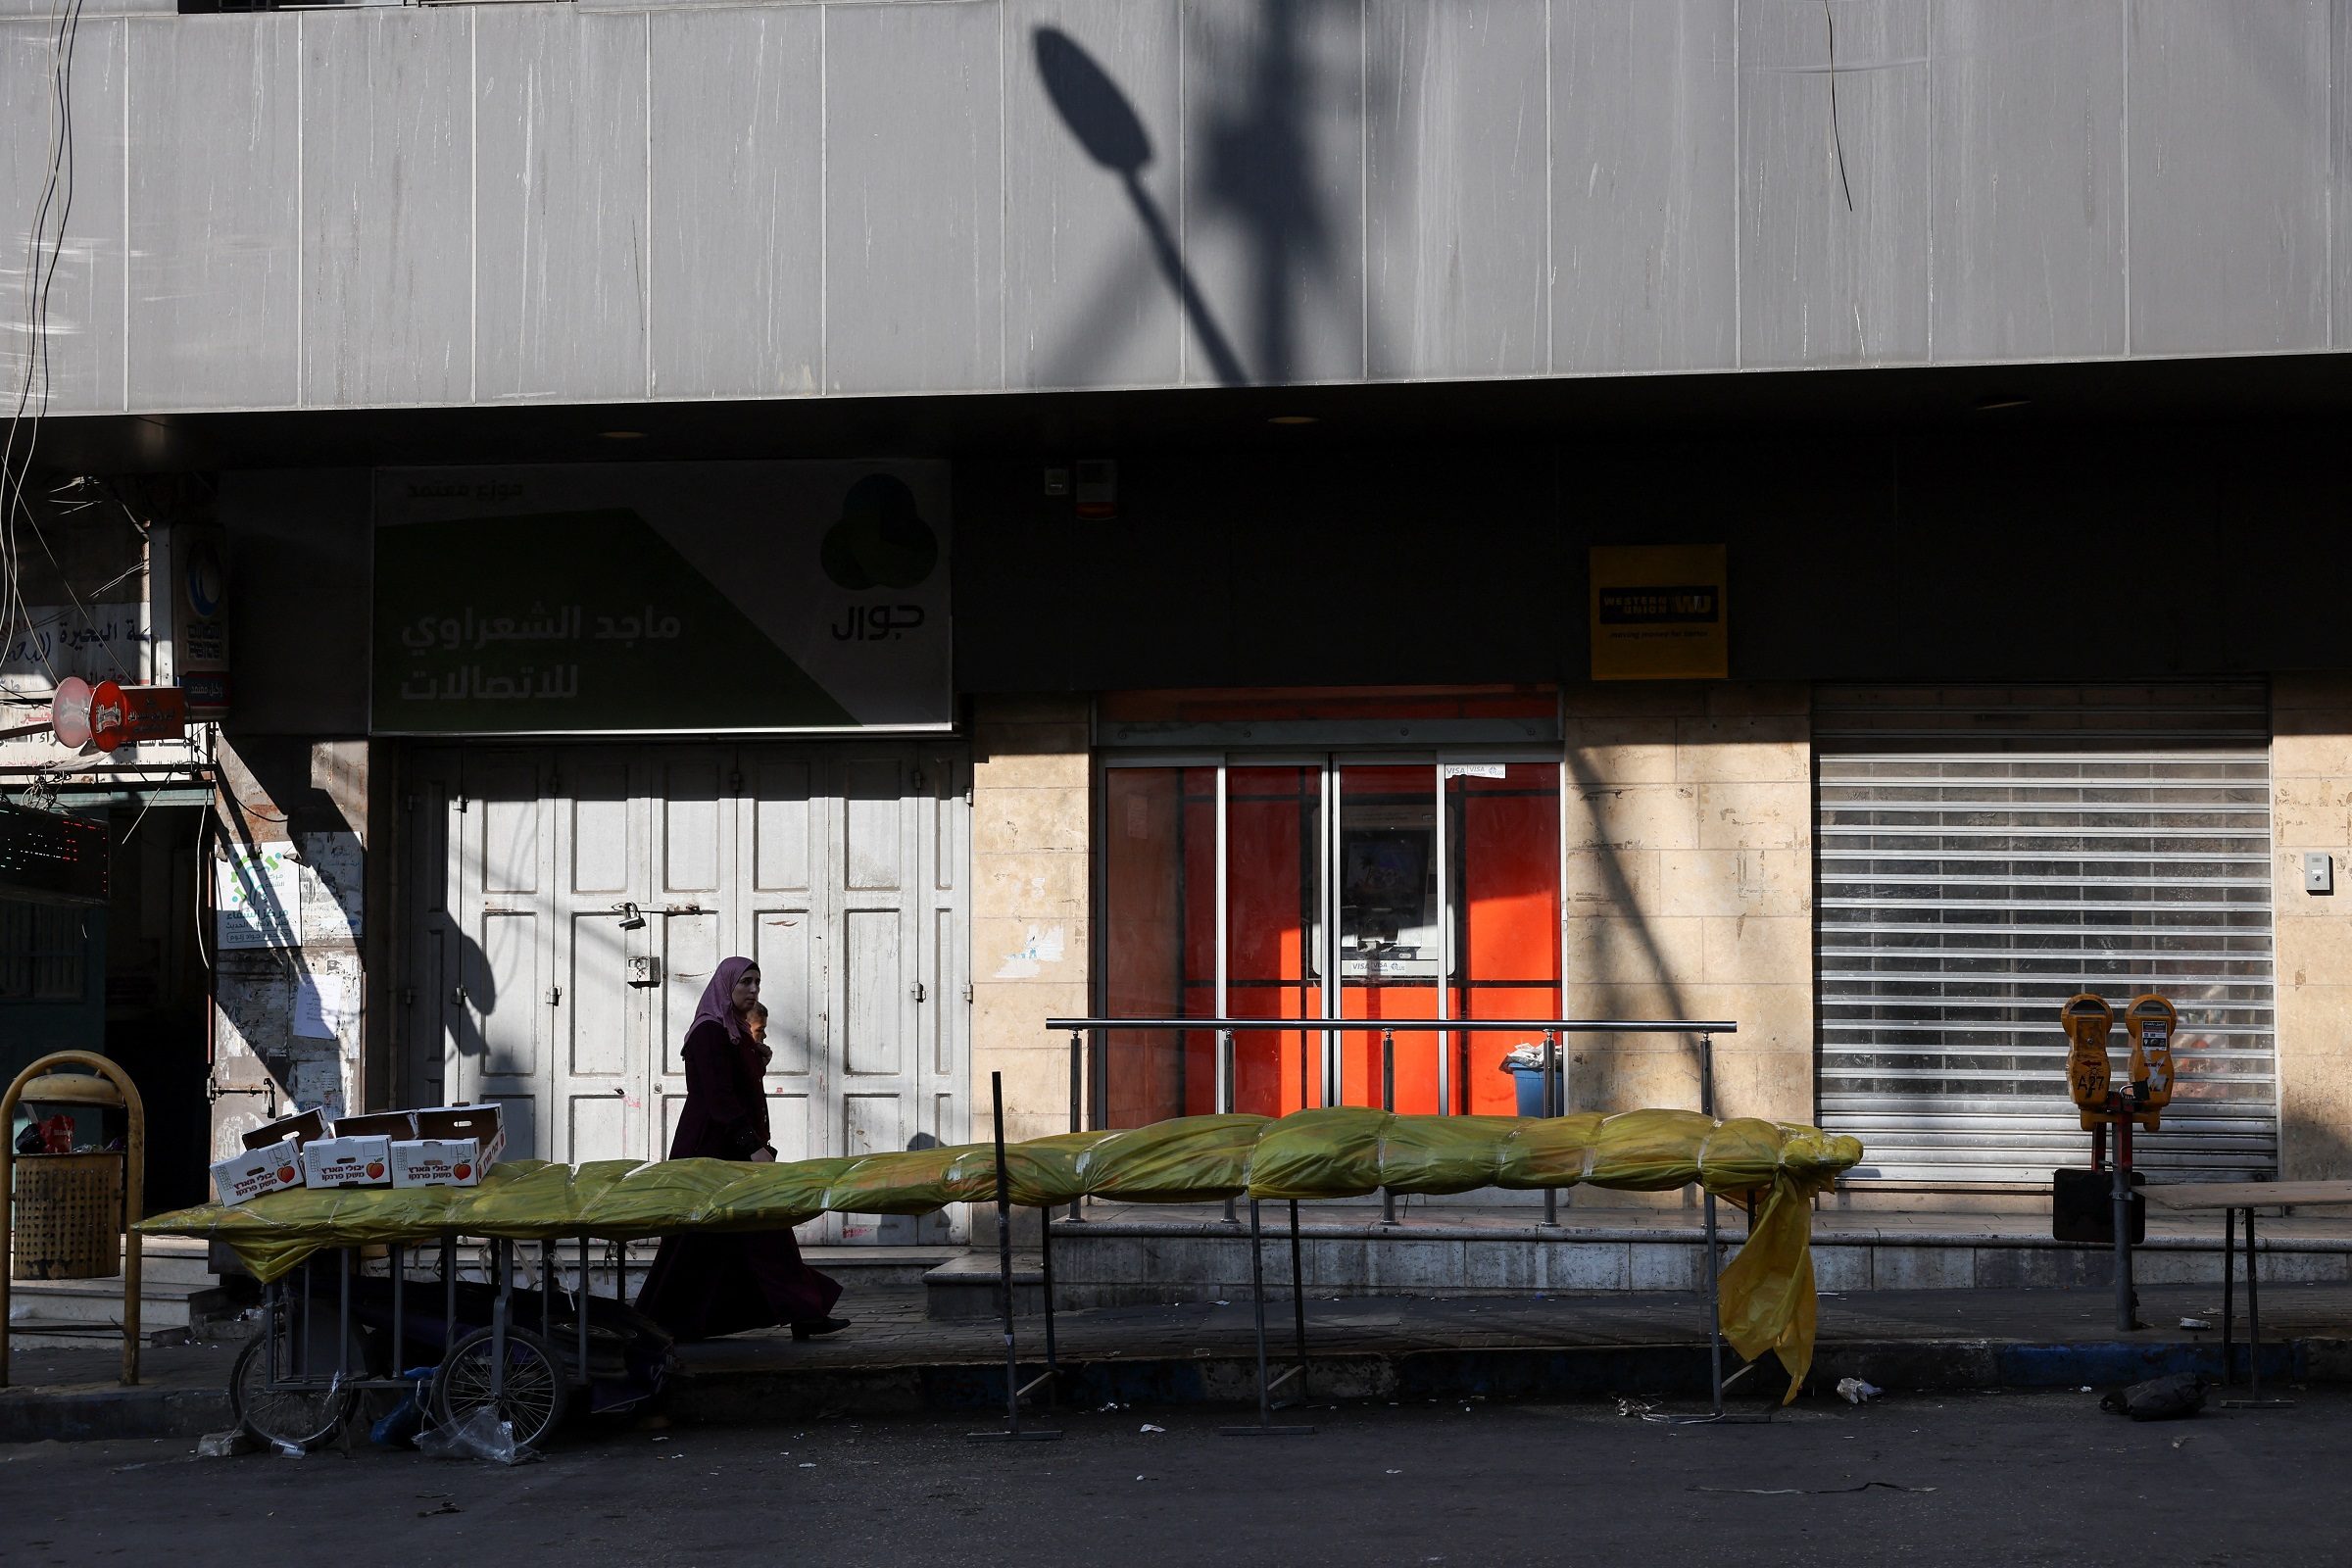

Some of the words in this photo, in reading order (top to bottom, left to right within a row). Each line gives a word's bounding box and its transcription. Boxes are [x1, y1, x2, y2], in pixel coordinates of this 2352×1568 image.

[407, 483, 469, 499] معتمد
[477, 483, 524, 501] موزع
[1603, 595, 1668, 606] WESTERN
[1623, 605, 1668, 614] UNION
[400, 596, 581, 657] الشعراوي
[594, 604, 682, 646] ماجد
[831, 604, 924, 642] جوال
[59, 621, 117, 652] البحيرة
[400, 663, 579, 701] للاتصالات
[2077, 1075, 2104, 1090] A27
[233, 1178, 256, 1190] הארץ
[257, 1171, 275, 1182] יבולי
[259, 1178, 277, 1190] משק
[321, 1173, 344, 1182] פרנקו
[235, 1184, 258, 1197] פרנקו
